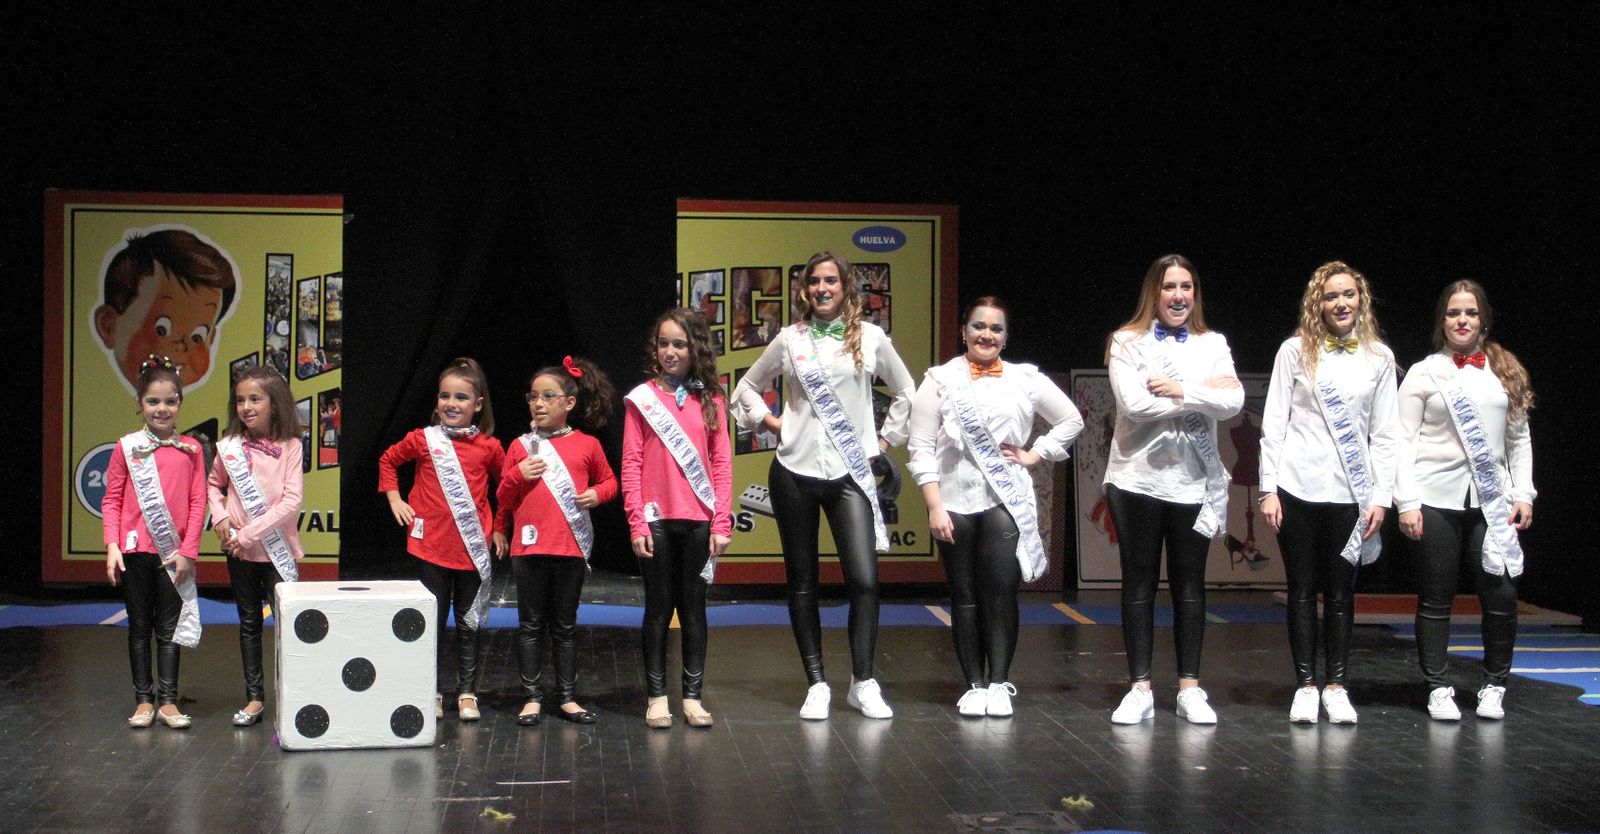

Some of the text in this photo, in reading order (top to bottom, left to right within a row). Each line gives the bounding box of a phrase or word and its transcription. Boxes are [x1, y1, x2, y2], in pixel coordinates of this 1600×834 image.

[859, 236, 896, 245] HUELVA
[805, 371, 871, 481] DAMA MAYOR 2018
[1333, 417, 1360, 464] MAYOR
[971, 432, 1005, 477] MAYOR
[1463, 425, 1491, 472] MAYOR
[235, 471, 259, 503] DAMA
[441, 468, 464, 503] DAMA
[529, 530, 535, 540] 3
